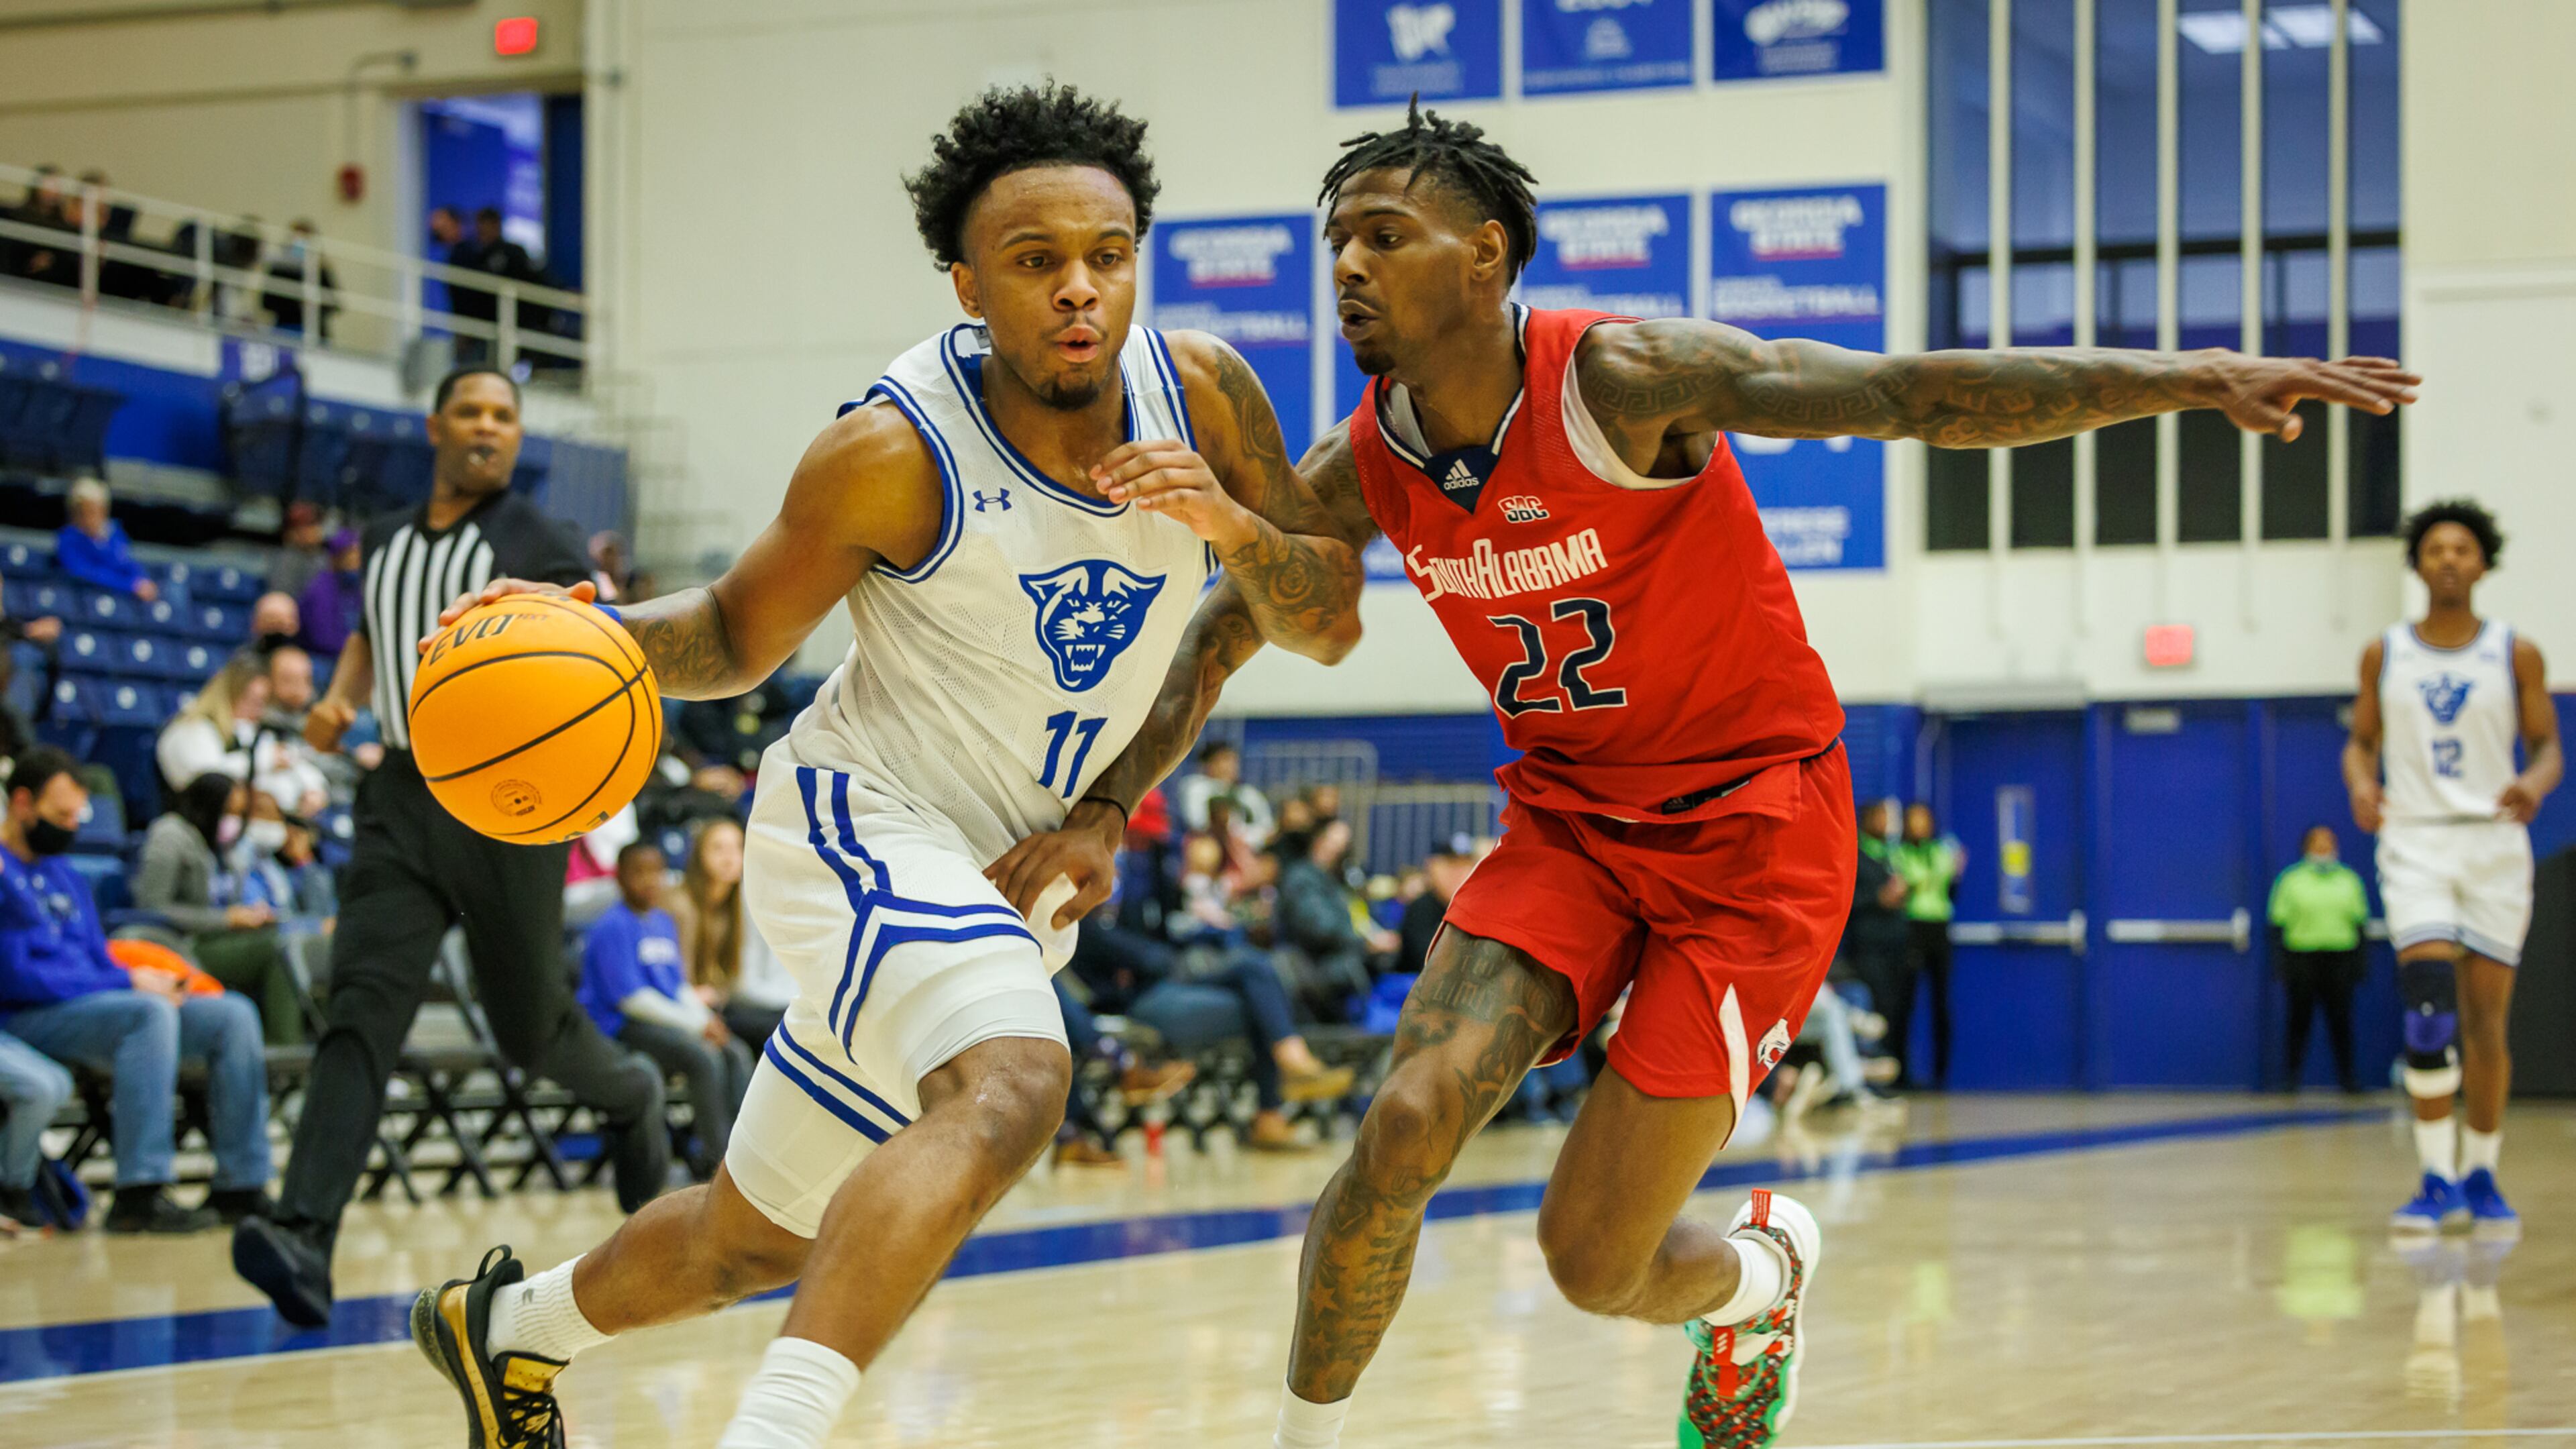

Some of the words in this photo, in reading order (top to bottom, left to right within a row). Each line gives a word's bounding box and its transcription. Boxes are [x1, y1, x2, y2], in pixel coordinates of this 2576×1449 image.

[1444, 476, 1479, 490] adidas
[429, 614, 516, 666] EVO
[1486, 596, 1628, 719] 22
[1037, 710, 1109, 799] 11
[2432, 738, 2465, 778] 12
